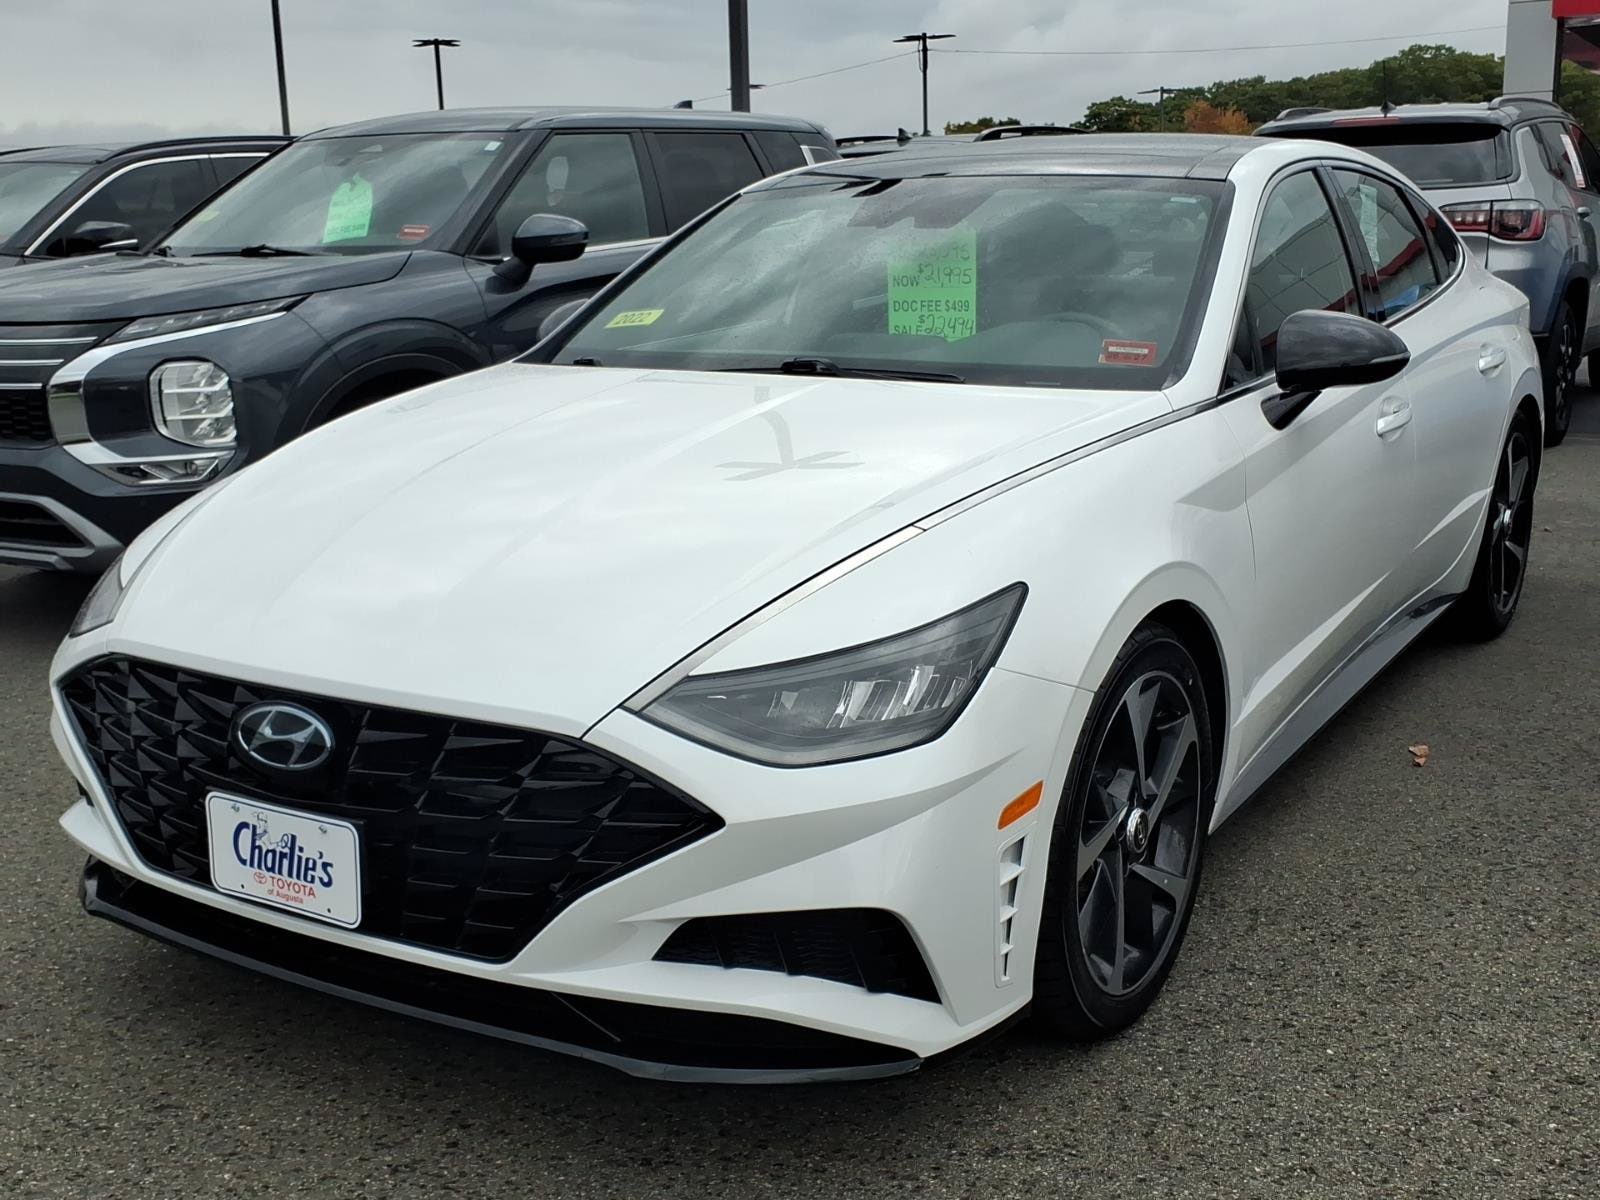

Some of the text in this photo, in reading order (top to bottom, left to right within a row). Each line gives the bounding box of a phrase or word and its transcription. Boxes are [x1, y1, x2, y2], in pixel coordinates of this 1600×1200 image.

[893, 263, 973, 288] NOW $21,995
[893, 300, 970, 312] DOC FEE $499
[613, 311, 652, 325] 2022
[894, 325, 922, 336] SALE
[232, 821, 334, 888] Charlie's
[269, 875, 316, 898] TOYOTA
[276, 889, 304, 905] Augusta
